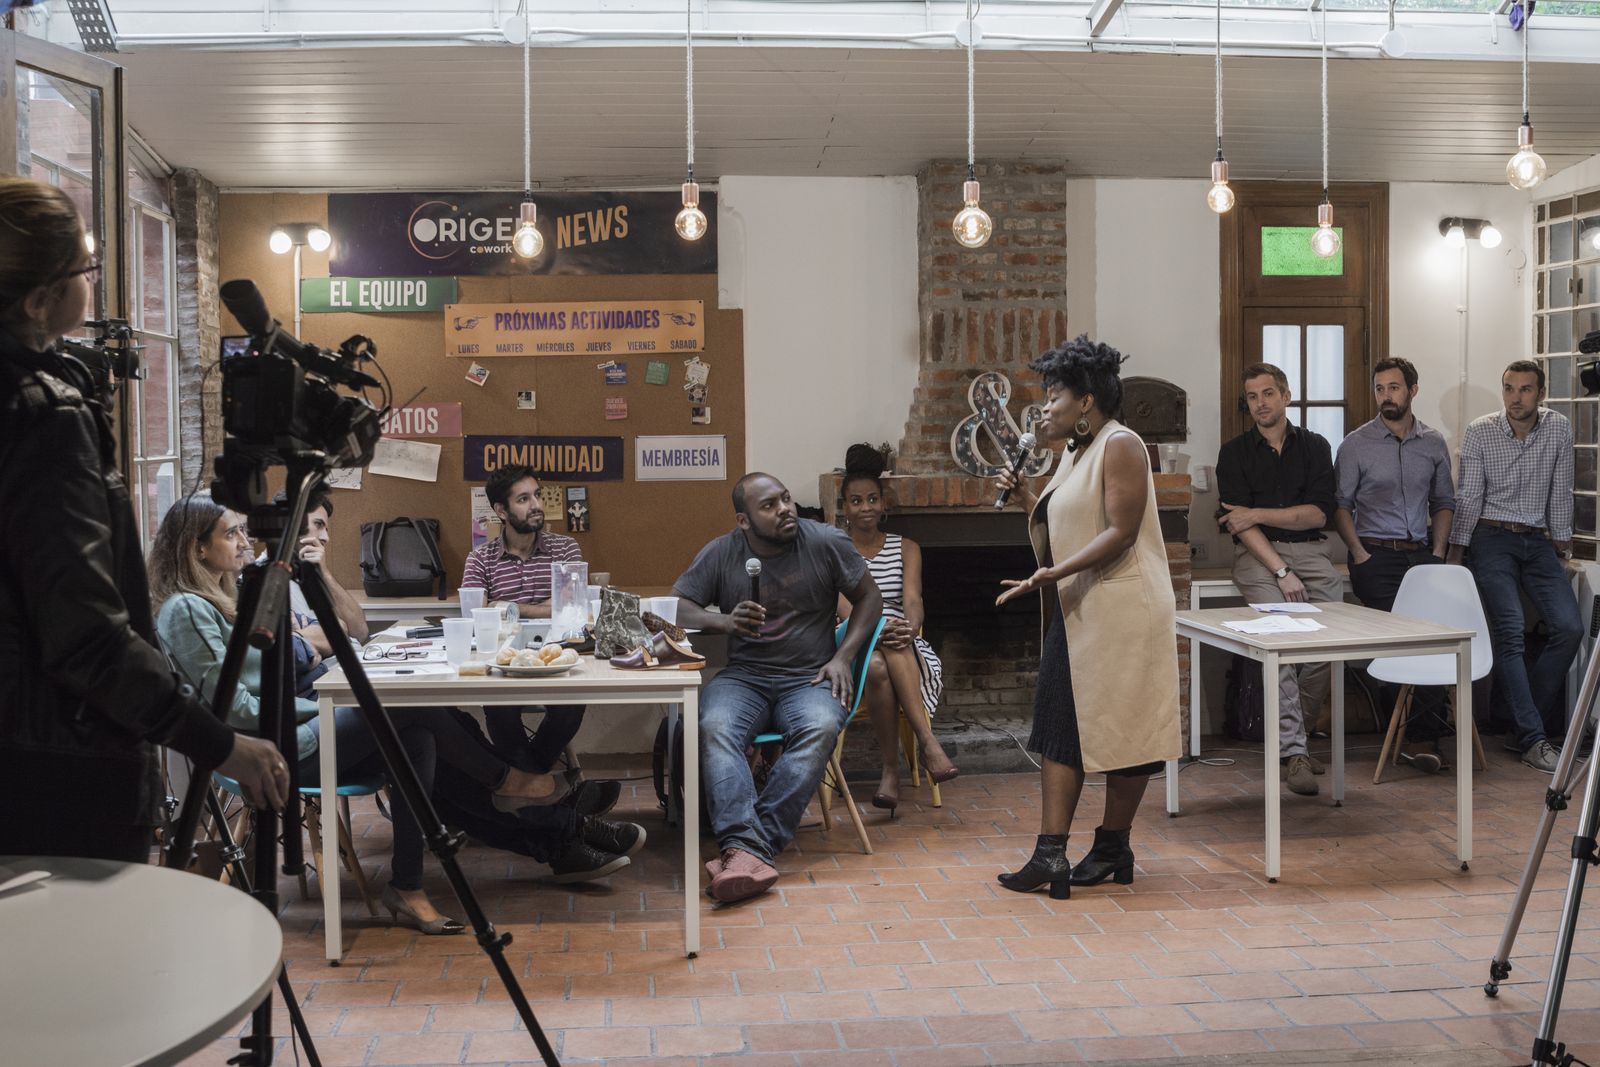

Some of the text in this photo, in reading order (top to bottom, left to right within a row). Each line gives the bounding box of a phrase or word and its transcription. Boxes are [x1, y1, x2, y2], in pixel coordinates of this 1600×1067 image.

[413, 217, 521, 242] ORIGE
[557, 205, 628, 249] NEWS
[330, 280, 427, 310] EL EQUIPO
[495, 309, 660, 331] PRÓXIMAS ACTIVIDADES
[458, 344, 480, 353] LUNES
[496, 343, 524, 353] MARTES
[586, 342, 612, 352] JUEVES
[627, 341, 656, 351] VIERNES
[483, 444, 604, 473] COMUNIDAD
[642, 446, 720, 467] MEMBRESÍA
